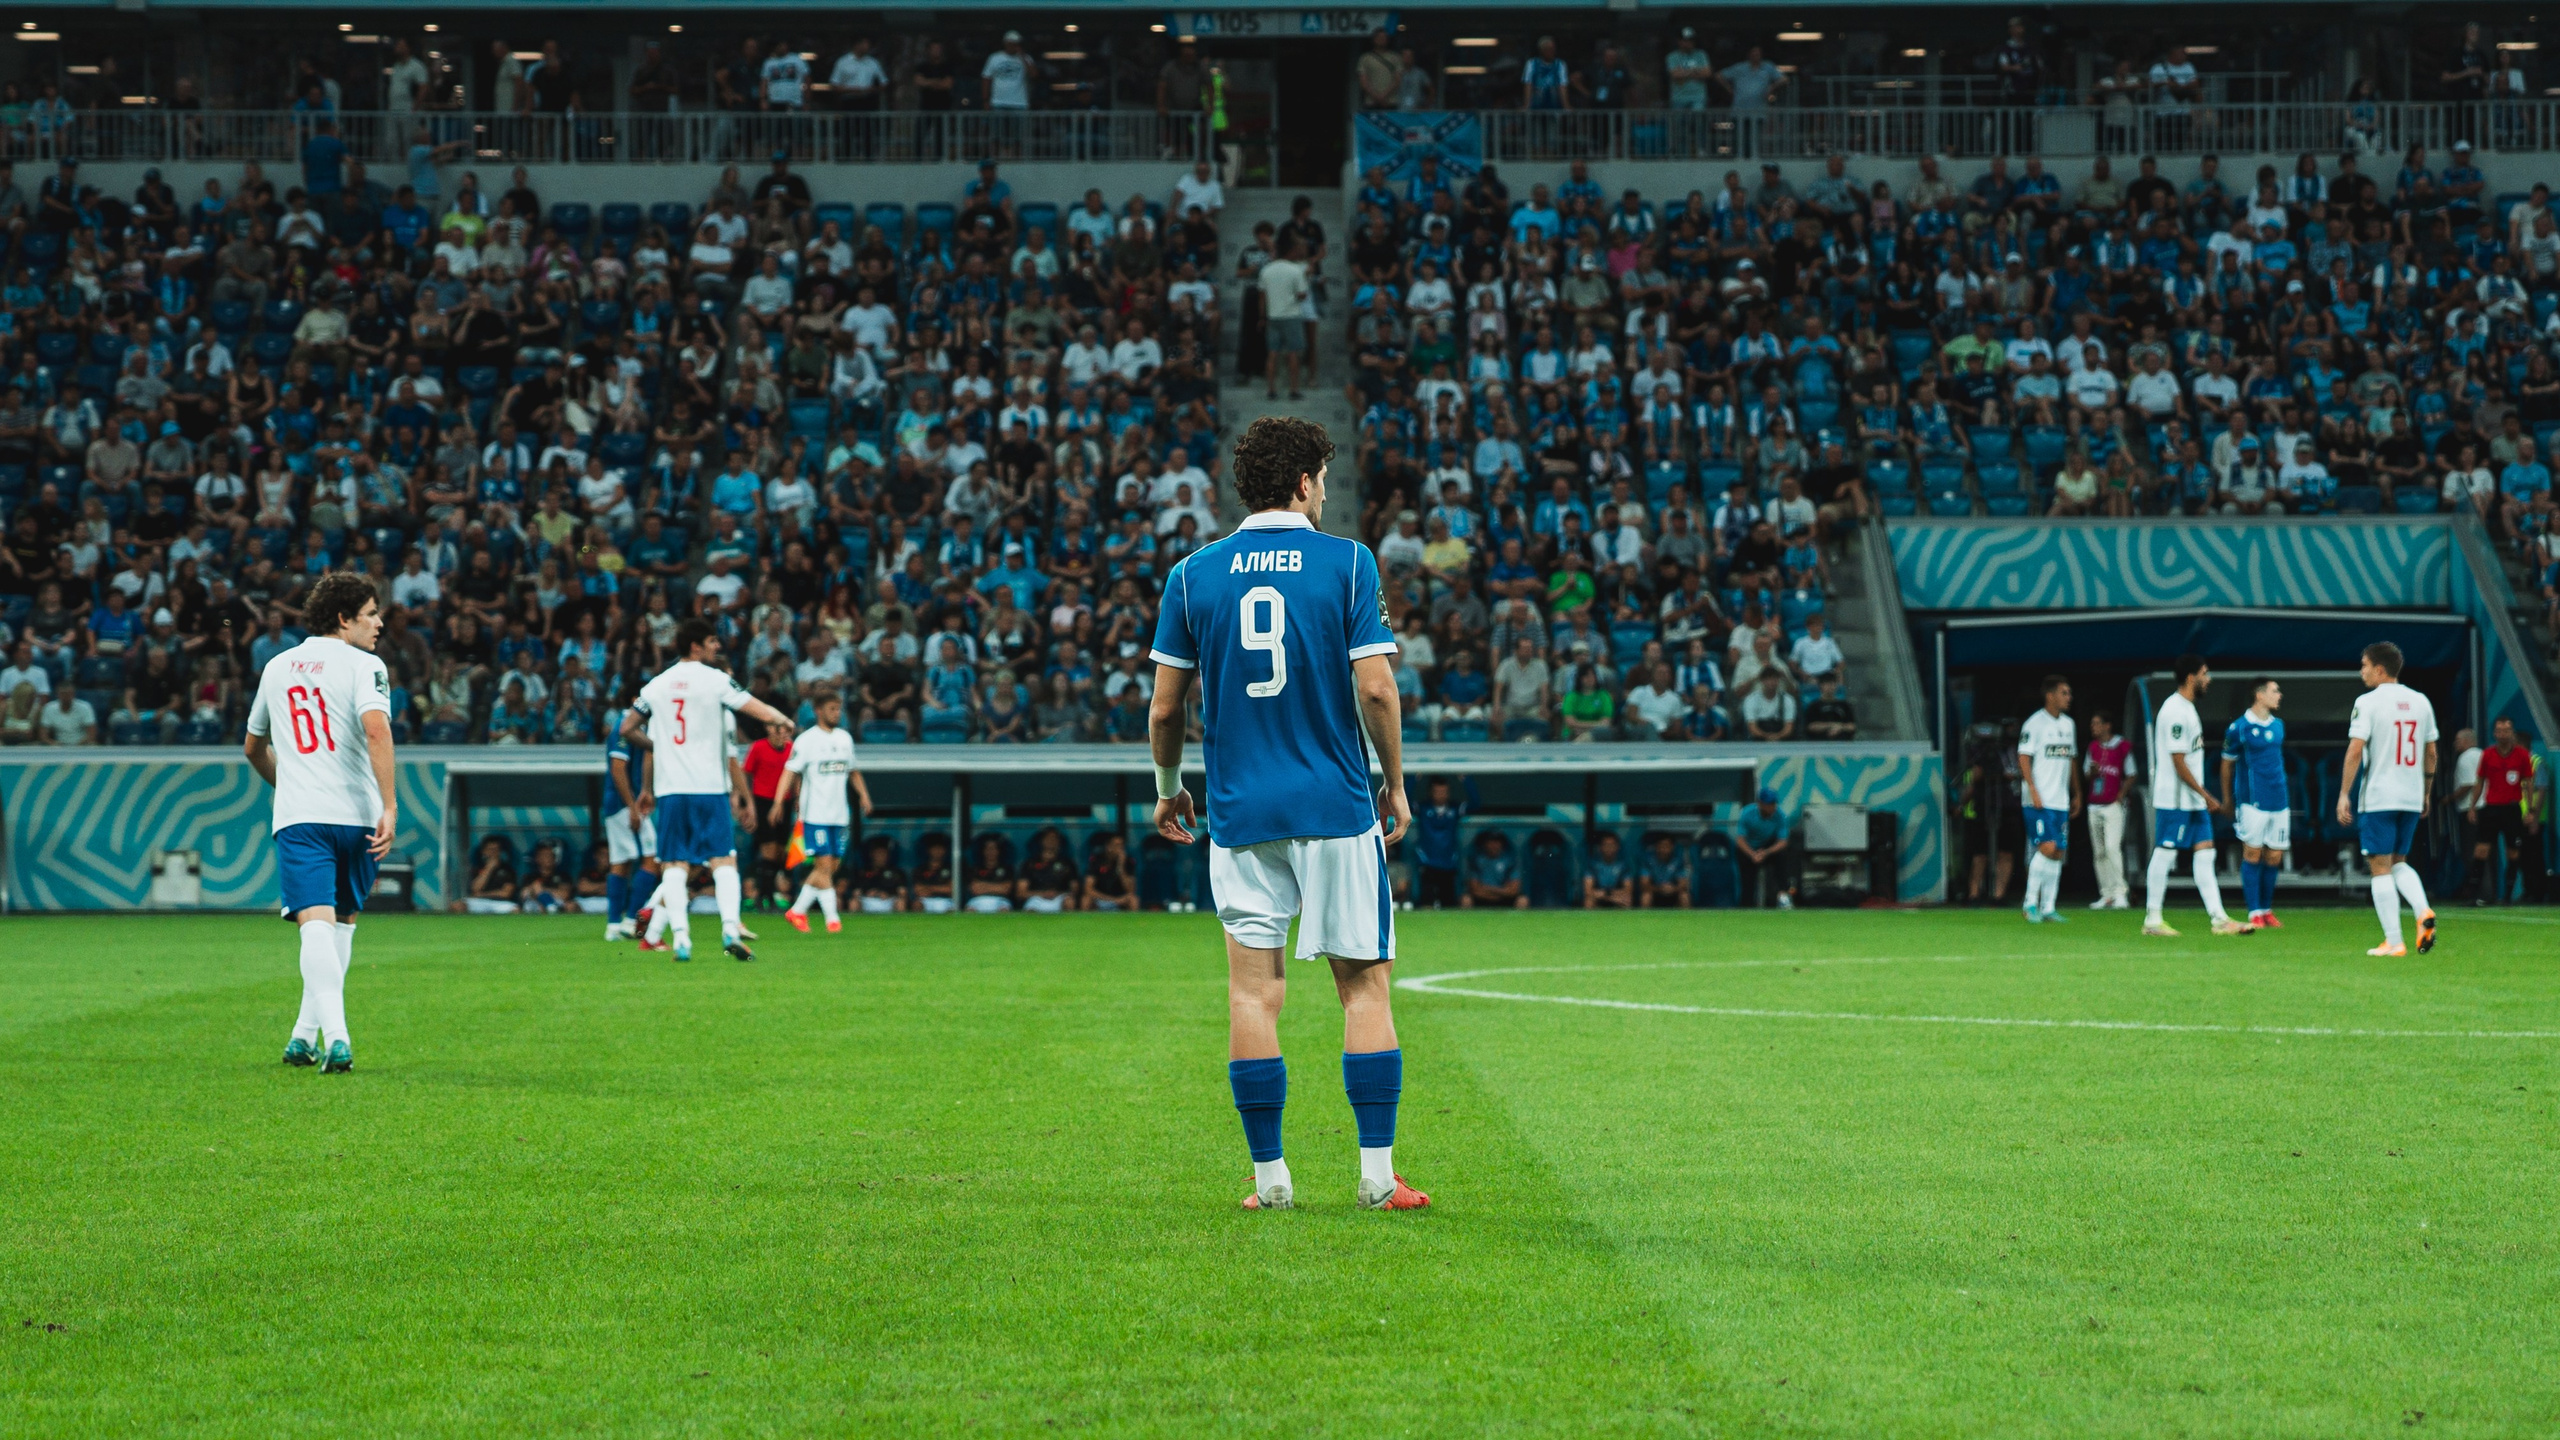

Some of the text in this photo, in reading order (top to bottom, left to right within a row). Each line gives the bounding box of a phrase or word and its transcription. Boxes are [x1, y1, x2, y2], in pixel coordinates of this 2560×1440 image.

[1218, 10, 1260, 32] 105
[1326, 10, 1369, 32] 104
[1229, 550, 1303, 574] АЛИЕВ
[1240, 586, 1287, 698] 9
[287, 685, 336, 755] 61
[671, 698, 686, 746] 3
[2394, 719, 2418, 768] 13
